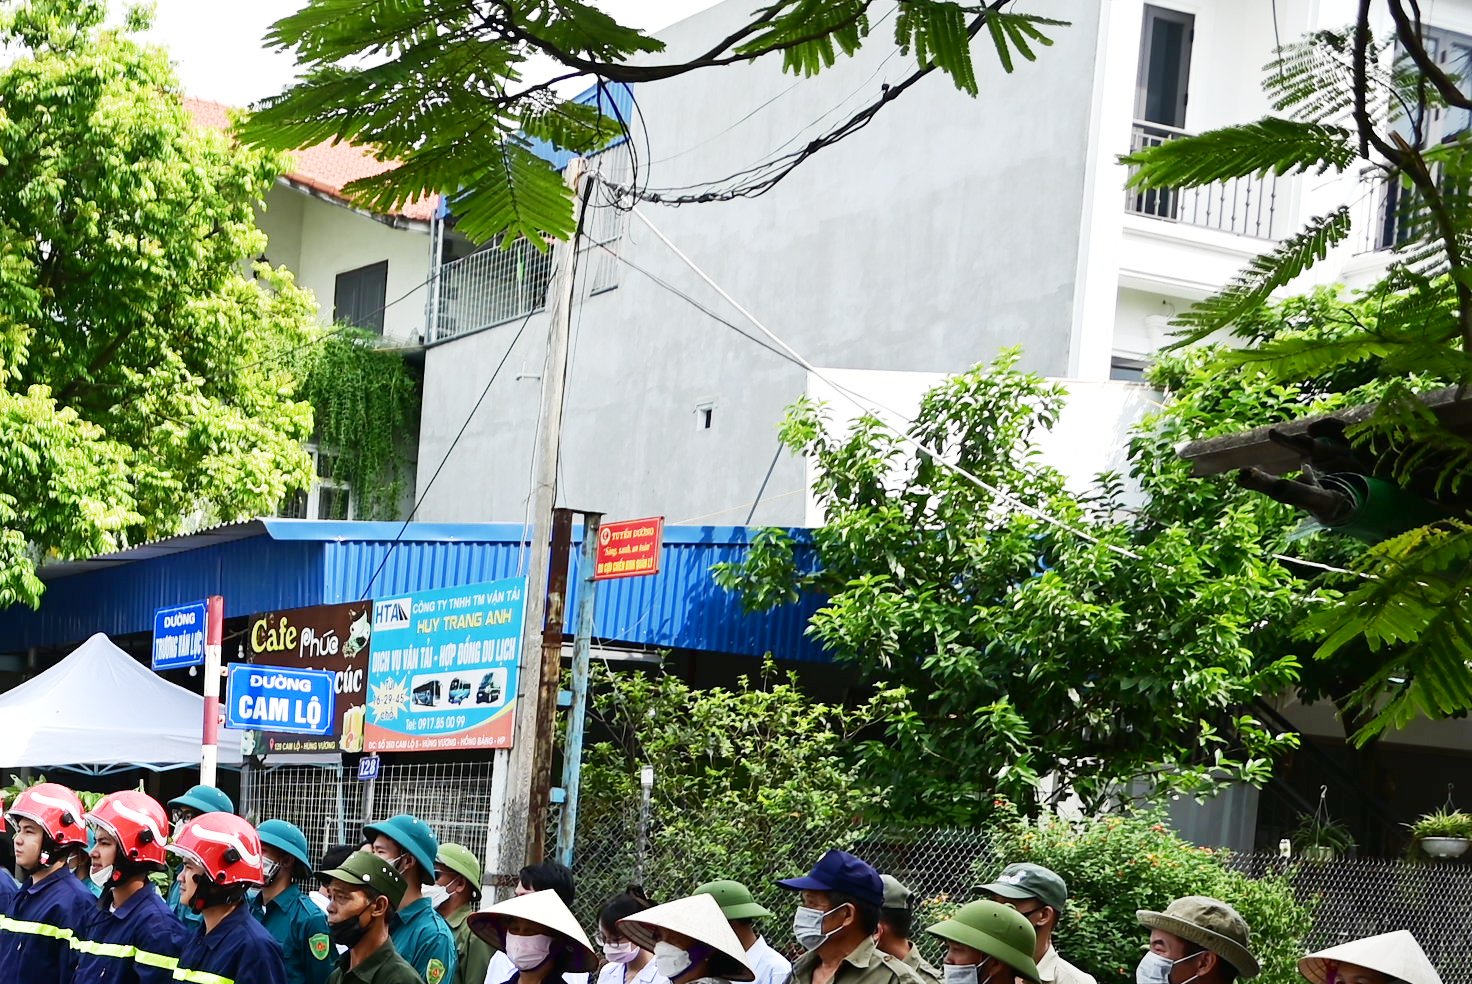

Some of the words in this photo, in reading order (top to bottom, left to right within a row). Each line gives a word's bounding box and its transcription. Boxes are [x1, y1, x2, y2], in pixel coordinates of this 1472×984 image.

[413, 601, 435, 614] CÔNG
[437, 600, 448, 610] TY
[449, 599, 471, 609] TNHH
[473, 594, 485, 605] TM
[487, 589, 504, 605] VẬN
[164, 612, 195, 628] ĐƯỜNG
[417, 617, 440, 634] HUY
[443, 612, 482, 631] TRANG
[485, 608, 512, 625] ANH
[251, 616, 297, 653] Cafe
[300, 627, 339, 658] Phúc
[372, 650, 390, 677] DỊCH
[391, 649, 403, 674] VỤ
[403, 644, 418, 674] VẬN
[420, 638, 433, 668] TẢI
[439, 642, 456, 671] HỢP
[482, 639, 495, 662] DU
[496, 637, 516, 666] LỊCH
[250, 674, 311, 692] ĐƯỜNG
[238, 695, 288, 722] CAM
[295, 695, 322, 729] LỘ
[445, 716, 455, 728] 00
[456, 715, 466, 727] 99
[360, 759, 375, 775] 128
